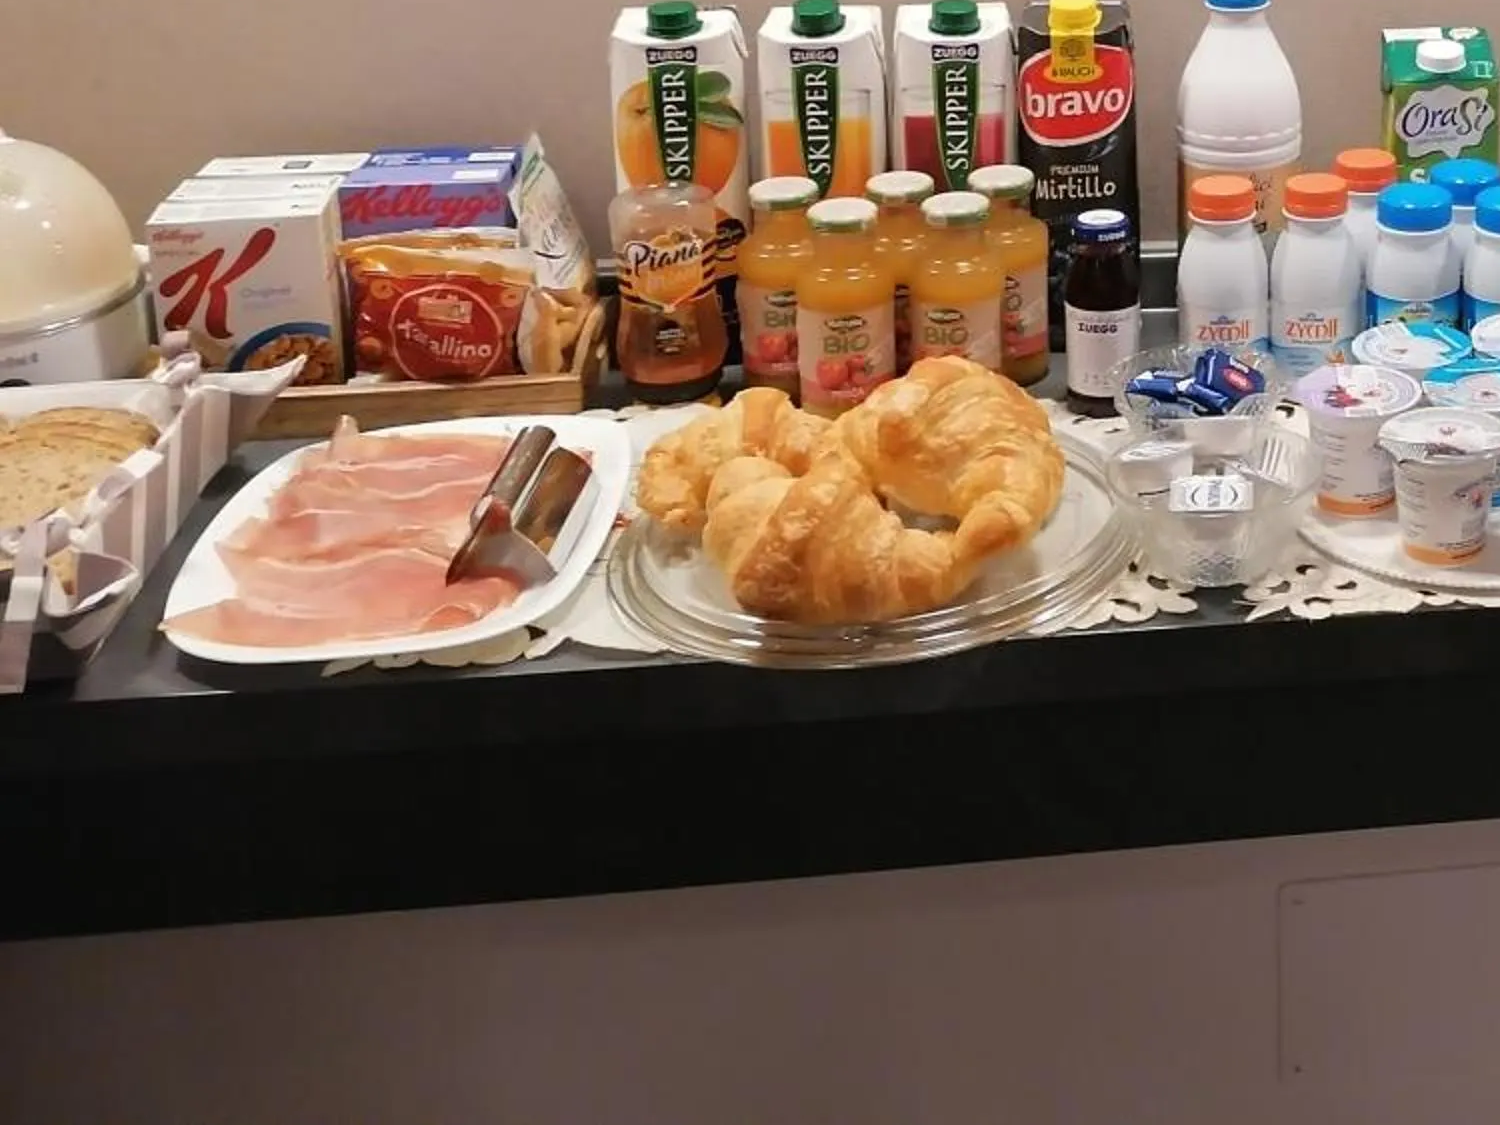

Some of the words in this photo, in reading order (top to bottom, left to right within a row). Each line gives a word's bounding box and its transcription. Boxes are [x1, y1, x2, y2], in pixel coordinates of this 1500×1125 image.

[648, 49, 696, 61] ZUEGG
[792, 49, 838, 61] ZUEGG
[932, 46, 979, 59] ZUEGG
[1025, 82, 1126, 118] bravo
[661, 69, 691, 178] SKIPPER
[805, 69, 832, 175] SKIPPER
[945, 64, 970, 170] SKIPPER
[1050, 165, 1100, 176] PREMIUM
[1035, 177, 1117, 201] Mirtillo
[159, 226, 277, 340] K
[823, 333, 870, 354] BIO
[923, 326, 969, 345] BIO
